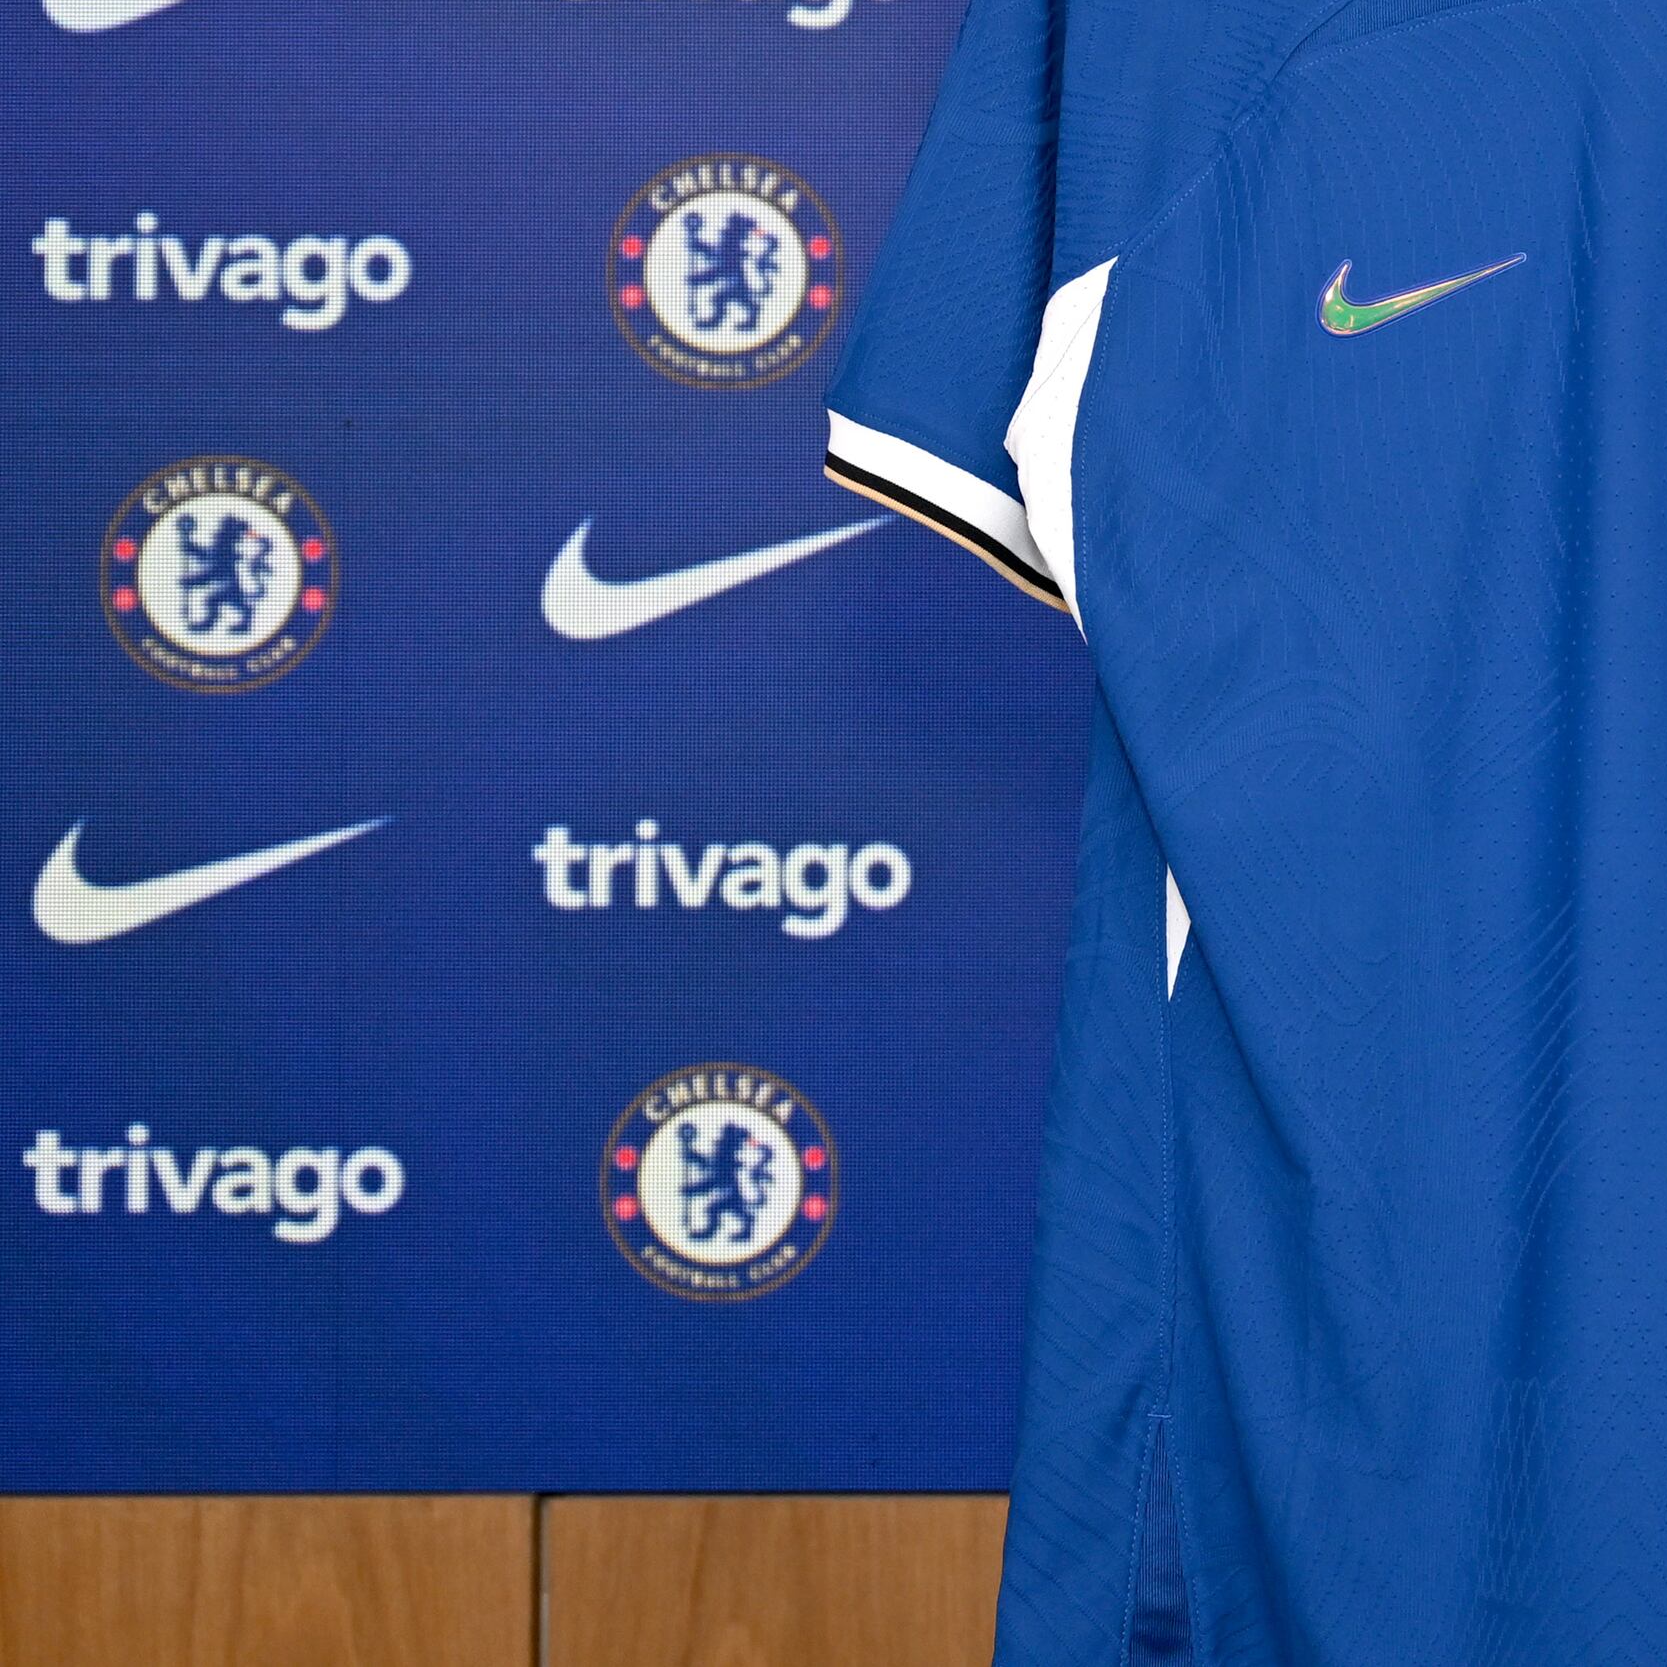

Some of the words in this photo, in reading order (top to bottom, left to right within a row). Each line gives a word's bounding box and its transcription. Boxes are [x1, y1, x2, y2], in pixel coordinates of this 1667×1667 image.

[648, 163, 799, 213] CHELSEA
[34, 214, 409, 330] trivago
[142, 465, 292, 516] CHELSEA
[535, 821, 910, 937] trivago
[643, 1073, 793, 1124] CHELSEA
[25, 1127, 402, 1242] trivago
